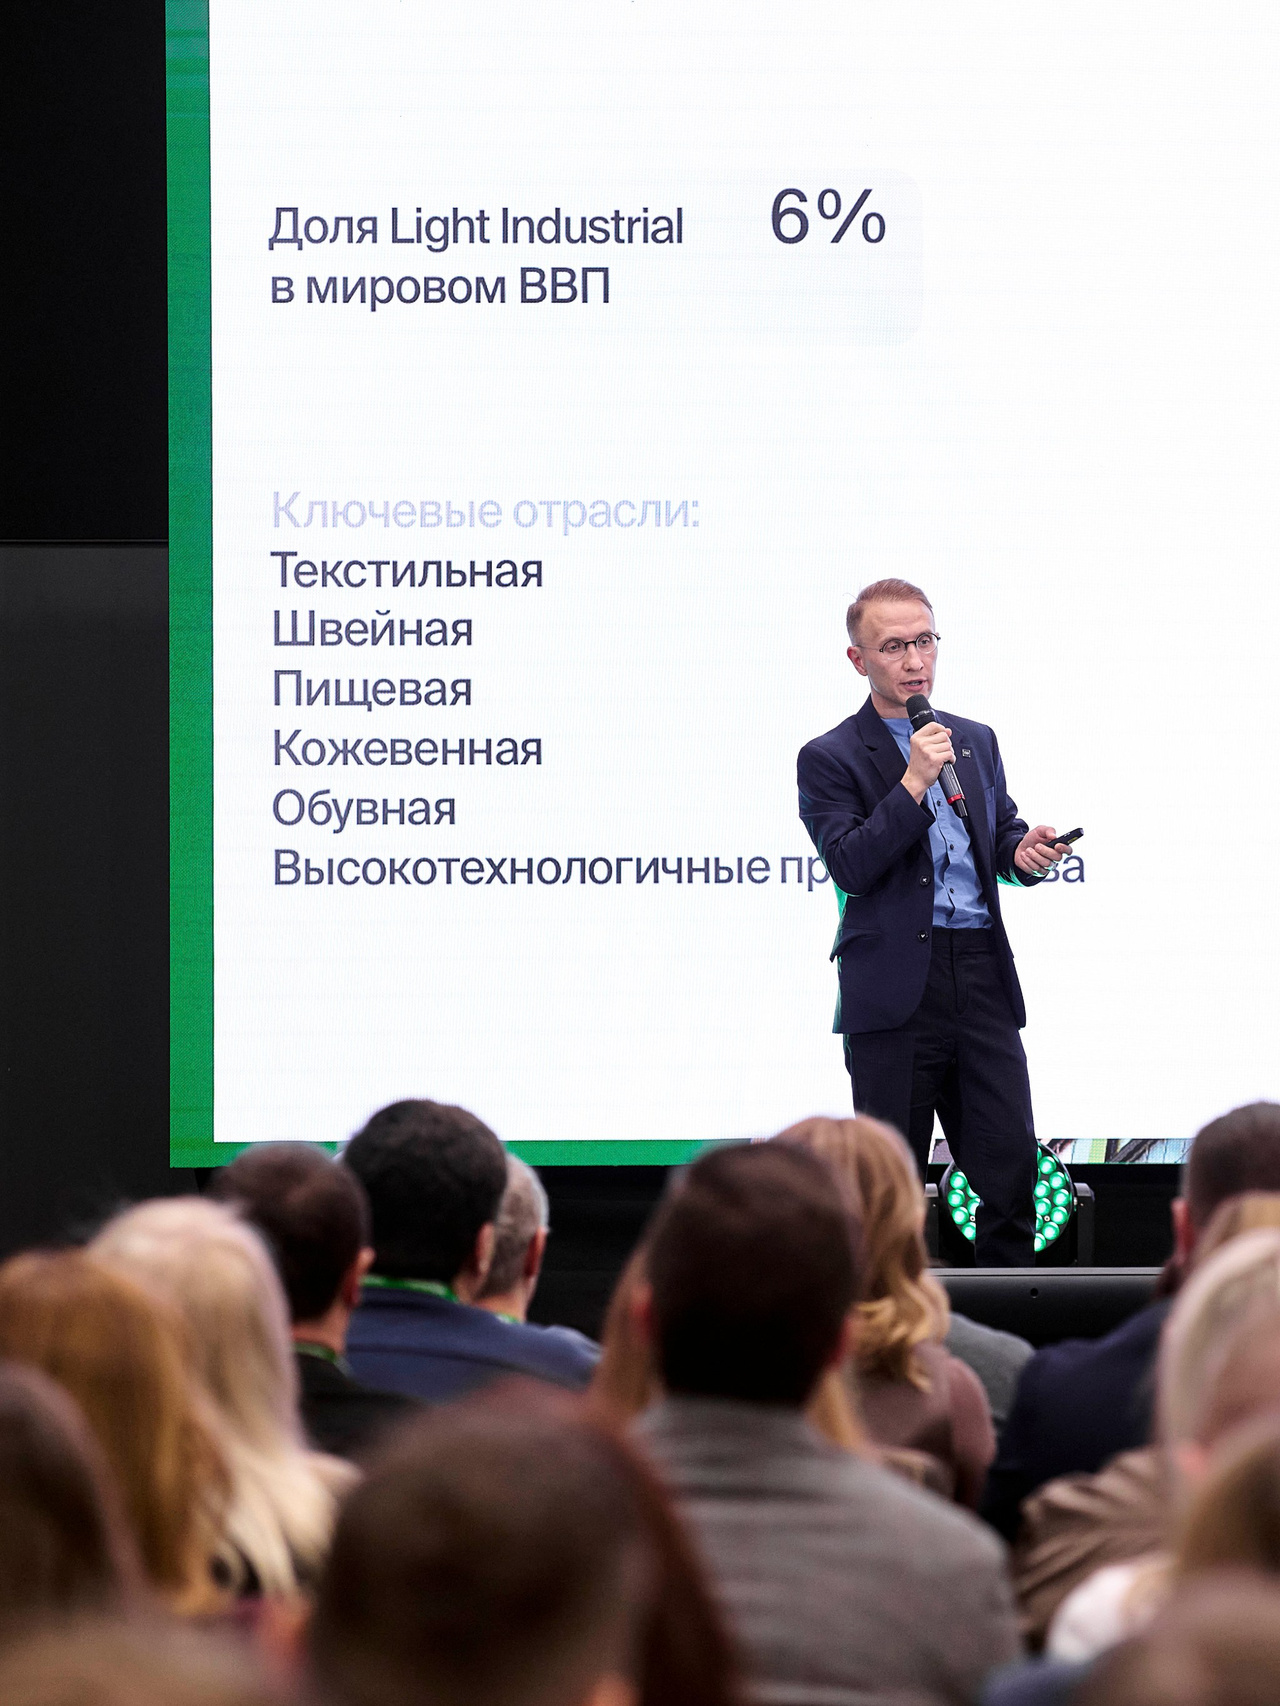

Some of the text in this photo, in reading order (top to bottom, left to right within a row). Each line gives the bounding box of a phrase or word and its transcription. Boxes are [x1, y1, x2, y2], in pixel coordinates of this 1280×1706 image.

[269, 207, 683, 252] Доля Light Industrial
[771, 187, 886, 245] 6%
[271, 266, 610, 313] в мировом ВВП
[273, 490, 700, 537] Ключевые отрасли:
[270, 551, 543, 589] Текстильная
[273, 609, 473, 647] Швейная
[274, 669, 472, 713] Пищевая
[274, 729, 542, 767] Кожевенная
[272, 788, 456, 835] Обувная
[274, 848, 771, 886] Высокотехнологичные
